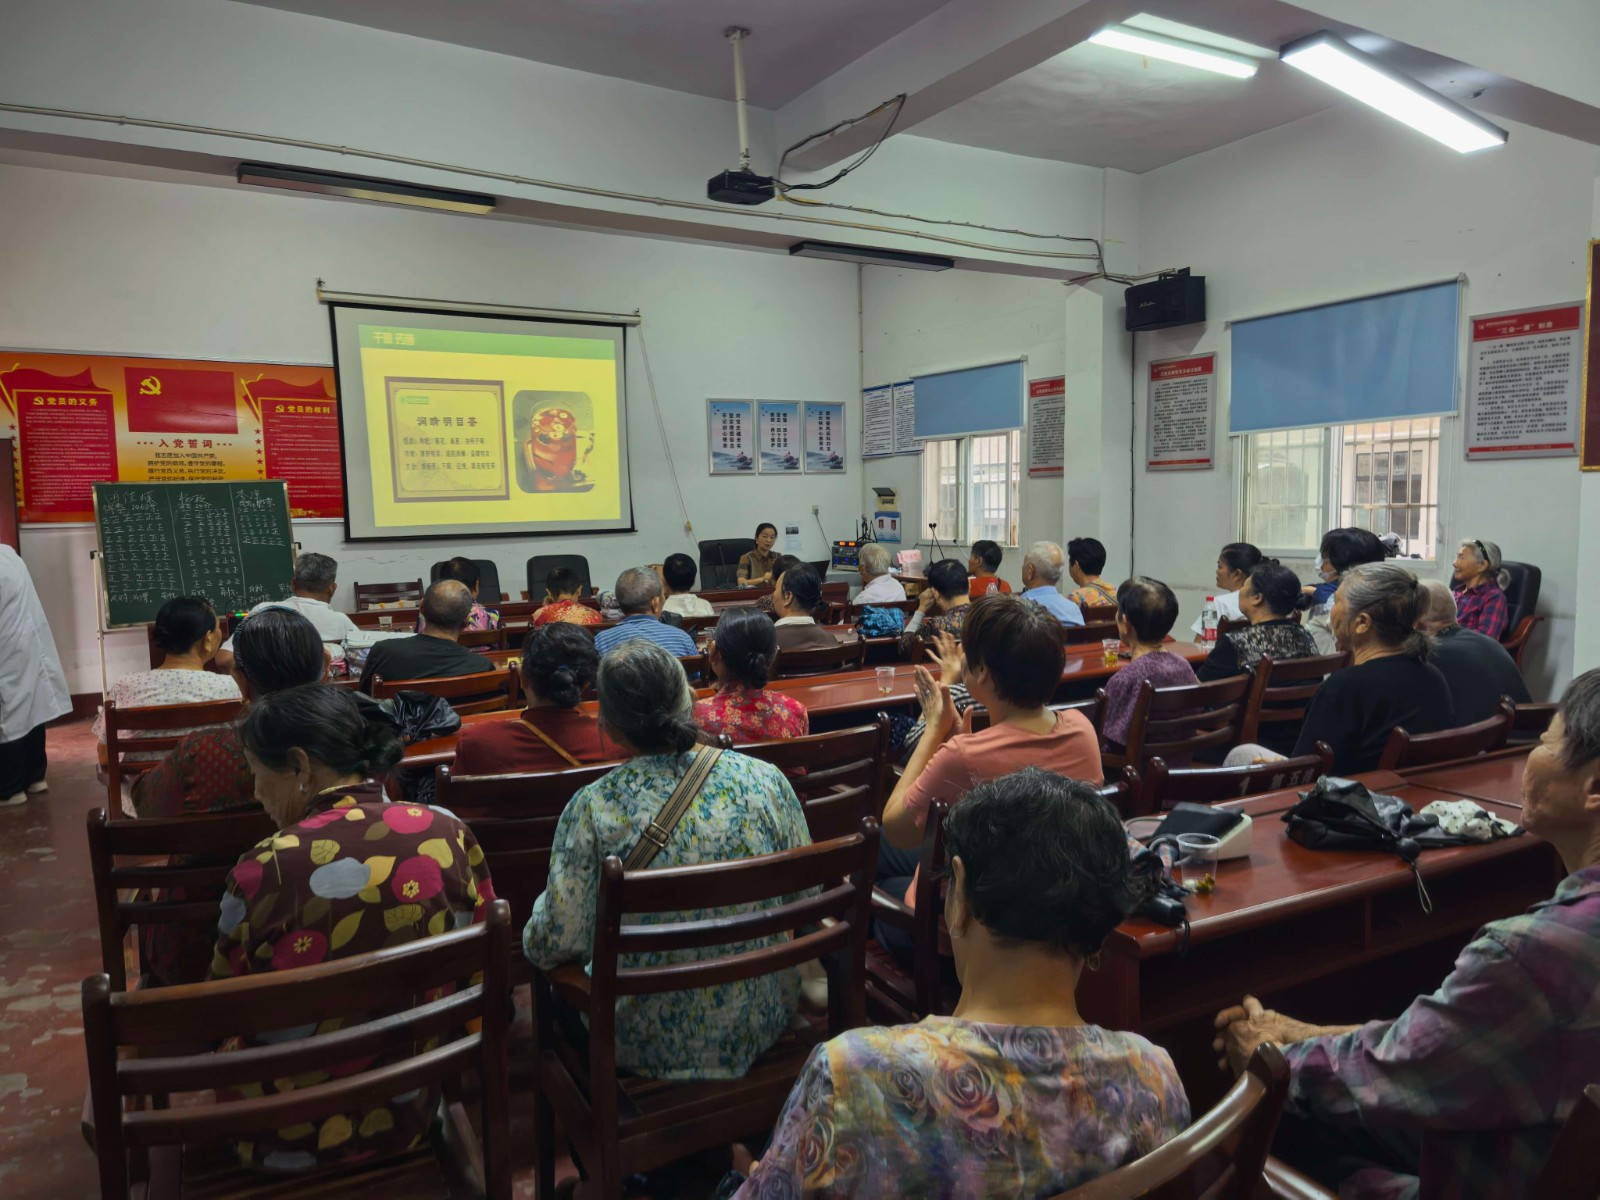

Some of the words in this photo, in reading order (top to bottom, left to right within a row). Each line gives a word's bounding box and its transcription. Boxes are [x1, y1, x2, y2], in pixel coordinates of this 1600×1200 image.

[47, 397, 97, 406] 党员的义务
[287, 404, 330, 414] 党员的权利
[158, 439, 213, 448] 入党誓词
